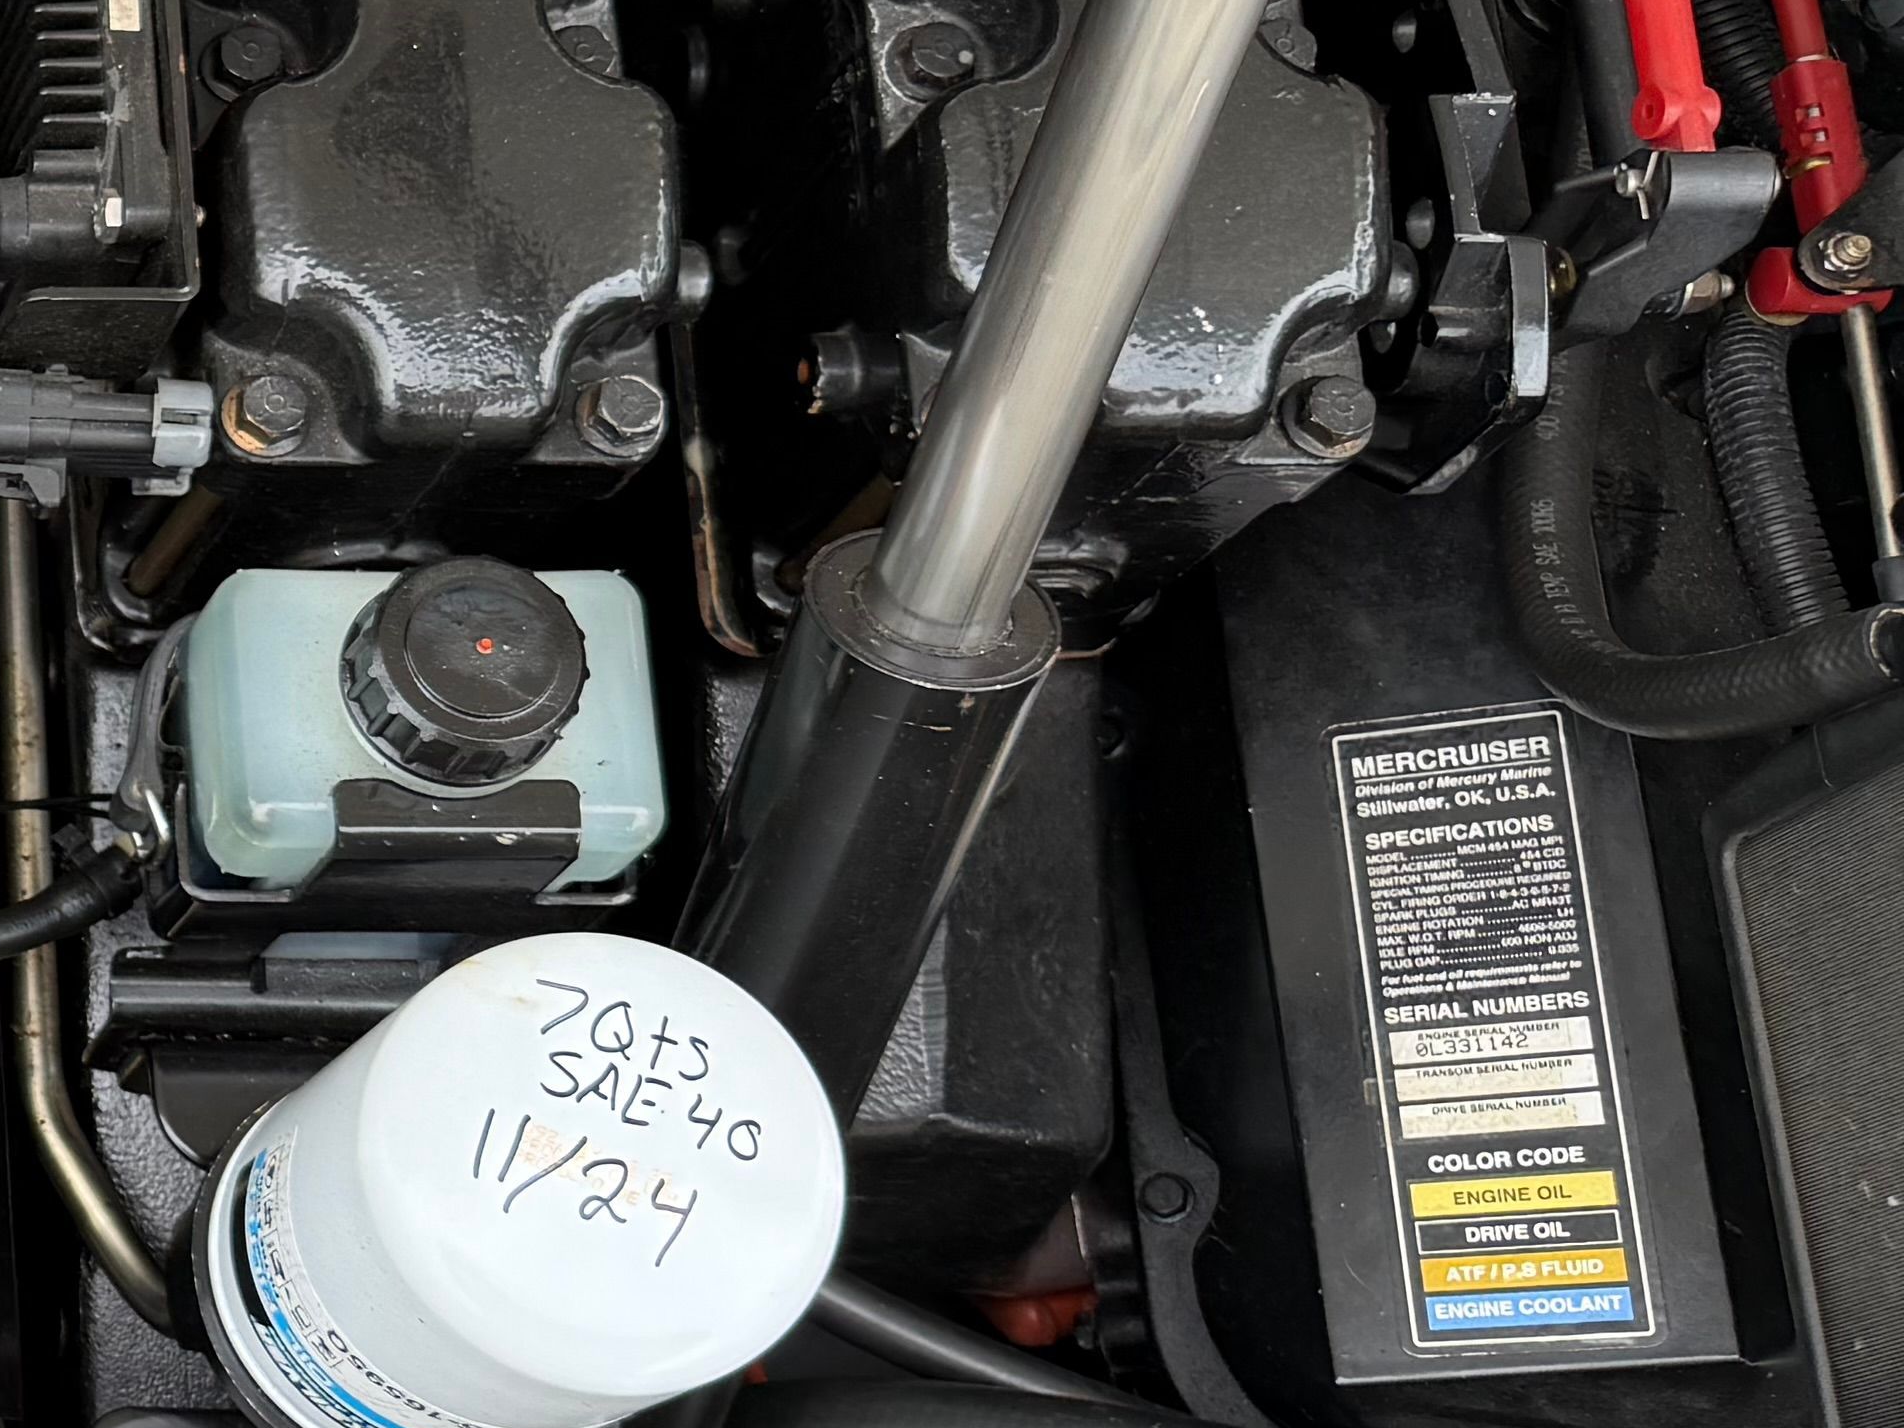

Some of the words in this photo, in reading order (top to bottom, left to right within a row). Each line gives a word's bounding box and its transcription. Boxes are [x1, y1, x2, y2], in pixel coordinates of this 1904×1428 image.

[1351, 735, 1552, 778] MERCRUISER
[1355, 778, 1415, 798] Division
[1418, 775, 1435, 790] of
[1437, 771, 1497, 791] Mercury
[1501, 765, 1553, 782] Marine
[1356, 794, 1451, 818] Stillwater,
[1455, 789, 1492, 806] OK,
[1495, 782, 1557, 802] U.S.A.
[1365, 814, 1555, 851] SPECIFICATIONS
[1457, 842, 1486, 855] MCM
[1367, 857, 1458, 876] DISPLACEMENT
[1376, 920, 1421, 935] ENGINE
[1422, 914, 1485, 931] ROTATION
[1383, 1001, 1469, 1025] SERIAL
[1471, 990, 1591, 1017] NUMBERS
[1428, 1150, 1513, 1173] COLOR
[1516, 1145, 1586, 1167] CODE
[472, 1107, 699, 1268] 11/24
[1453, 1186, 1532, 1206] ENGINE
[1537, 1184, 1573, 1201] OIL
[1464, 1223, 1530, 1243] DRIVE
[1533, 1221, 1571, 1240] OIL
[1446, 1264, 1487, 1283] ATF
[1541, 1258, 1605, 1277] FLUID
[1434, 1300, 1515, 1320] ENGINE
[1518, 1294, 1623, 1315] COOLANT
